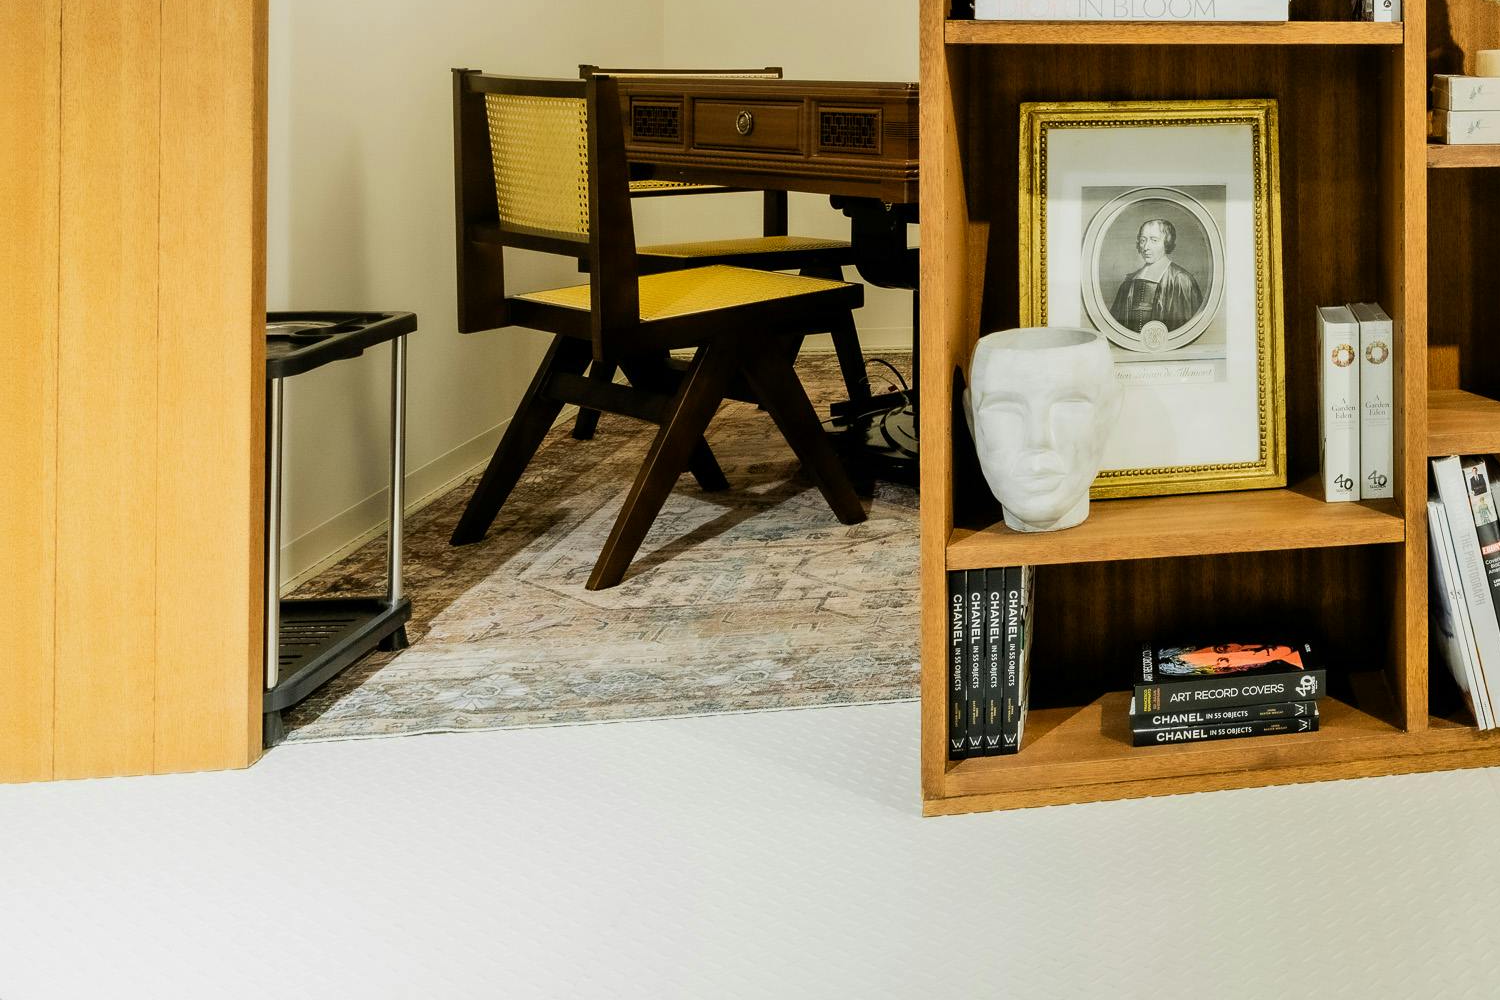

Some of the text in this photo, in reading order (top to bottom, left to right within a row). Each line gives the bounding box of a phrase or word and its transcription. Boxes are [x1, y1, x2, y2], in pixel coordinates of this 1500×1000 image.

[1334, 473, 1354, 491] 40
[1367, 469, 1388, 487] 40
[953, 594, 962, 646] CHANEL
[971, 592, 980, 644] CHANEL
[990, 591, 999, 643] CHANEL
[1008, 590, 1018, 642] CHANEL
[954, 665, 962, 691] OBJECTS
[1169, 691, 1192, 703] ART
[1194, 687, 1239, 700] RECORD
[1241, 683, 1285, 696] COVERS
[1152, 712, 1204, 725] CHANEL
[1222, 711, 1249, 719] OBJECTS
[1156, 729, 1208, 742] CHANEL
[1226, 727, 1253, 735] OBJECTS
